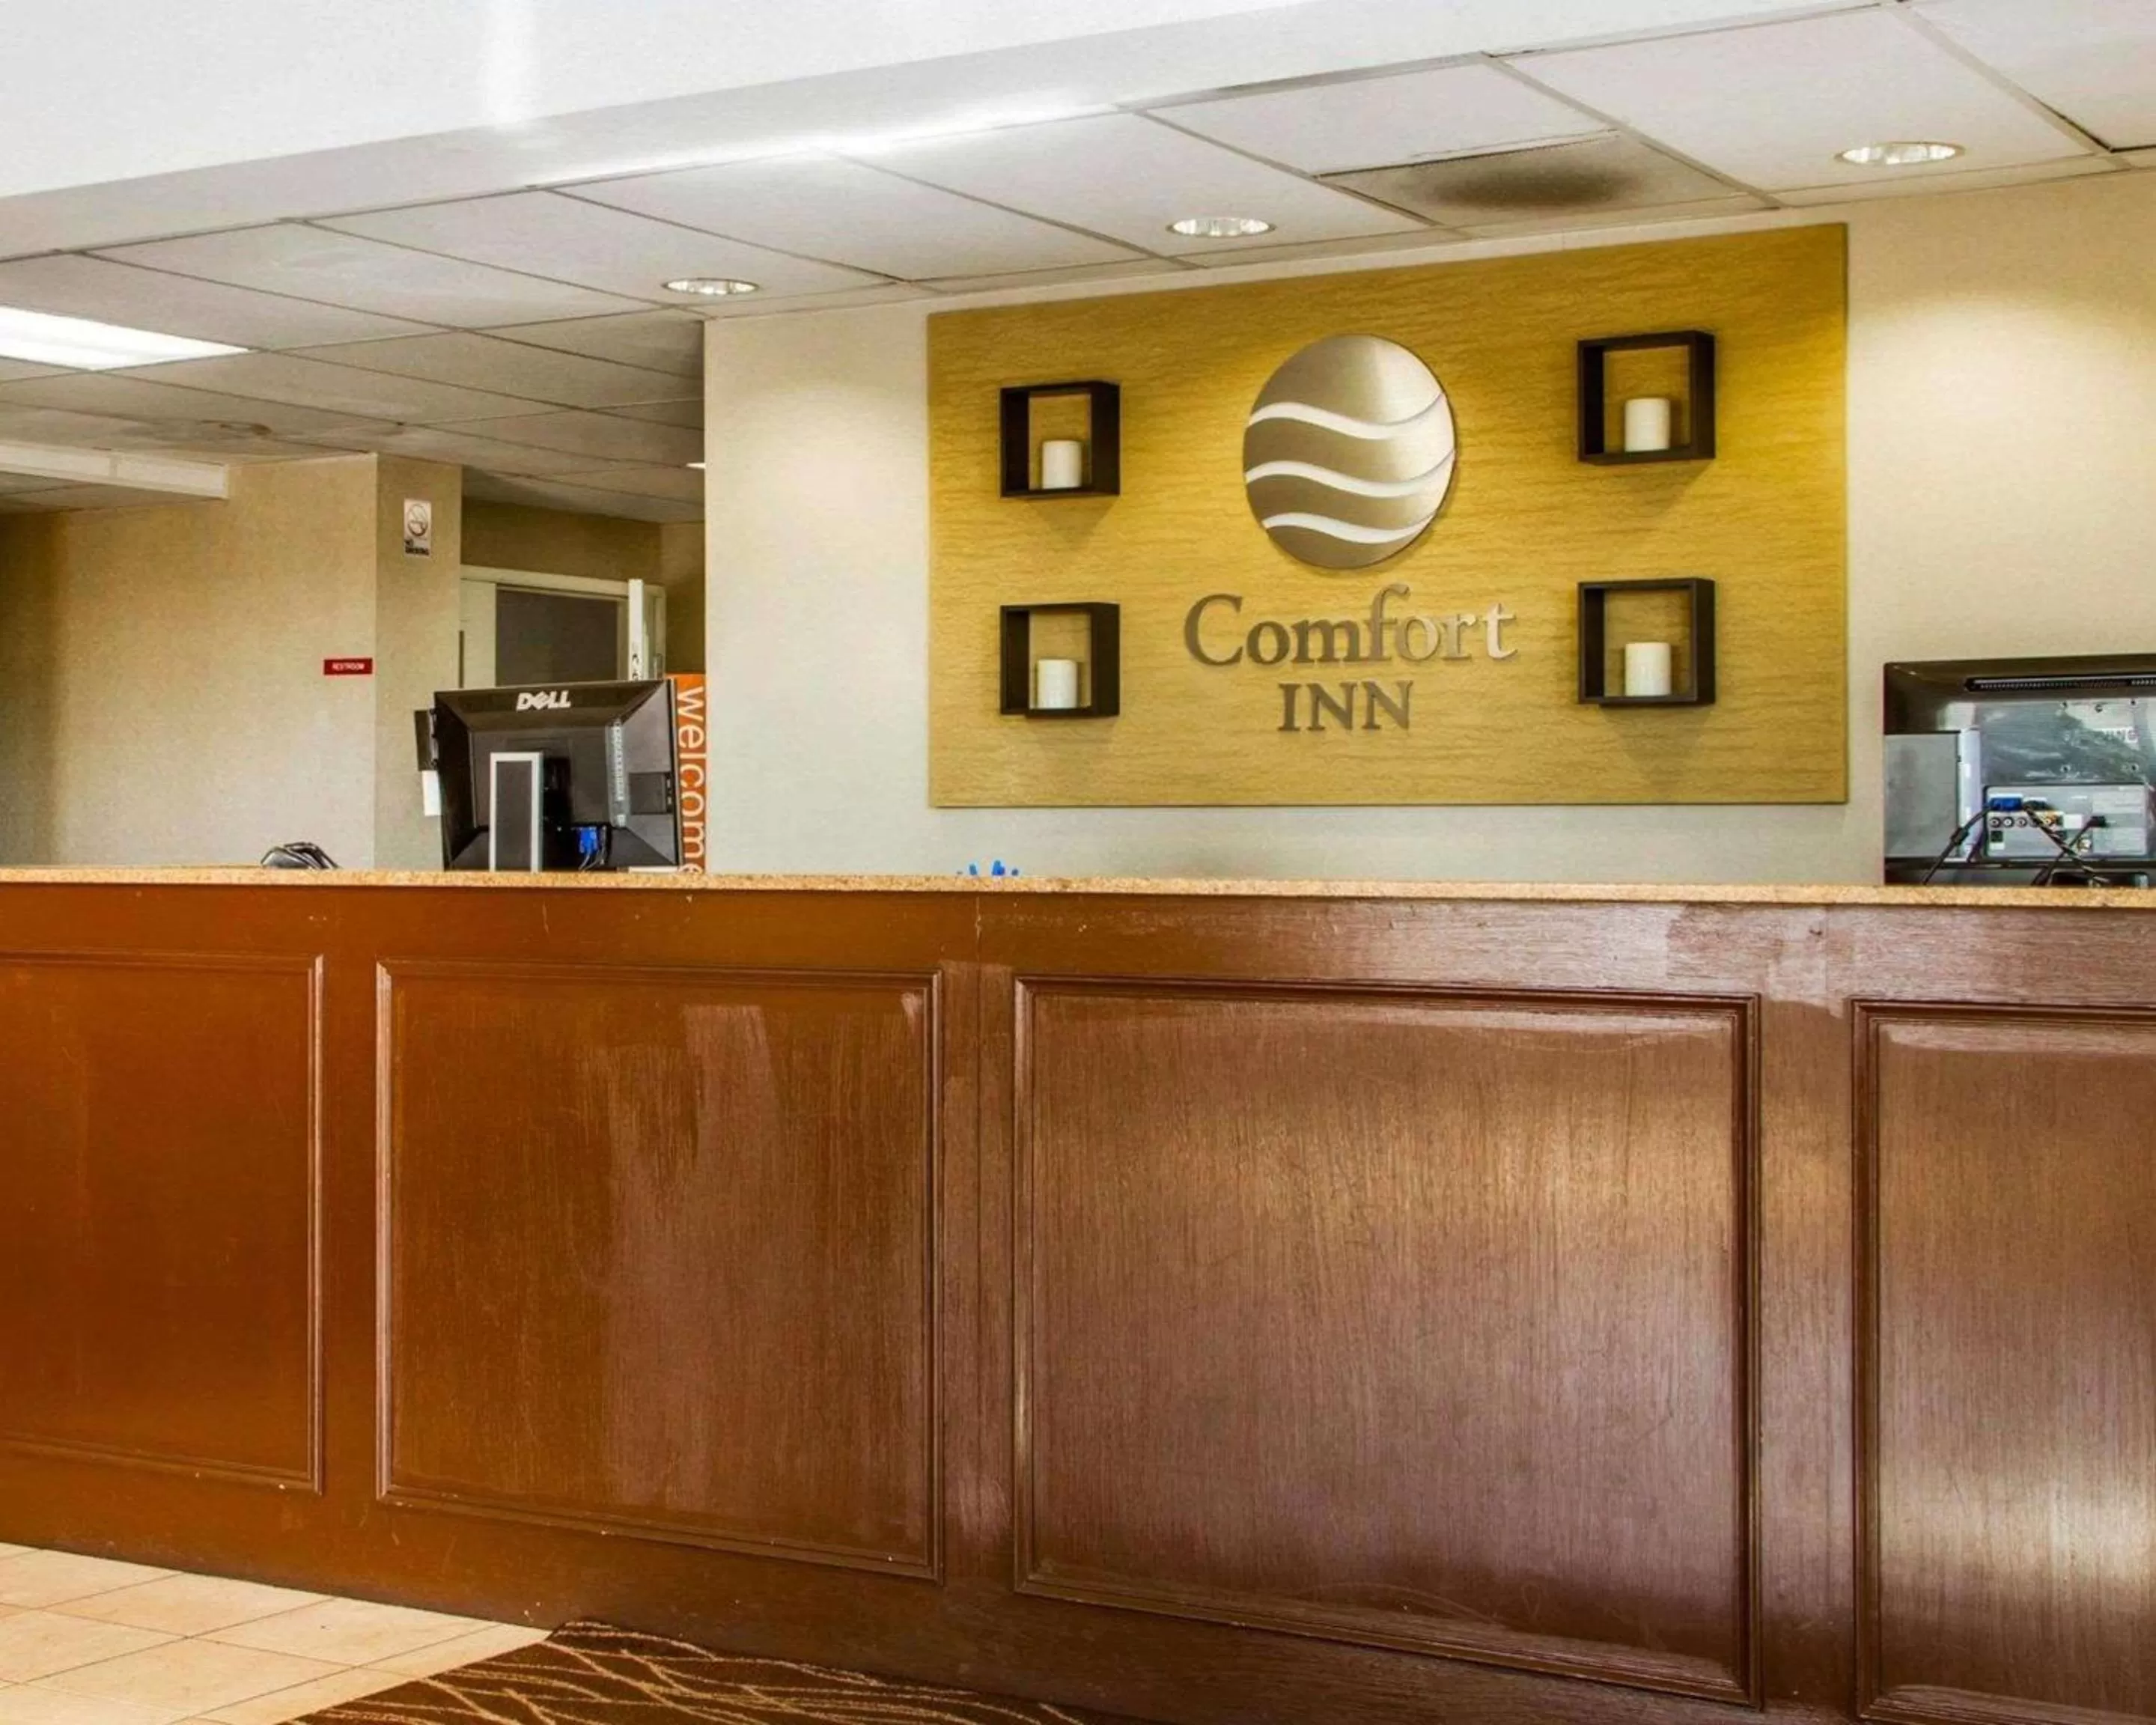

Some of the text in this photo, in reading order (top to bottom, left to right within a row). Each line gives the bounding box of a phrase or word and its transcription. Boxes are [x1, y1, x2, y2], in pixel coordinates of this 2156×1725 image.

[1184, 583, 1517, 666] Comfort
[516, 690, 571, 711] DELL
[1277, 680, 1413, 731] INN
